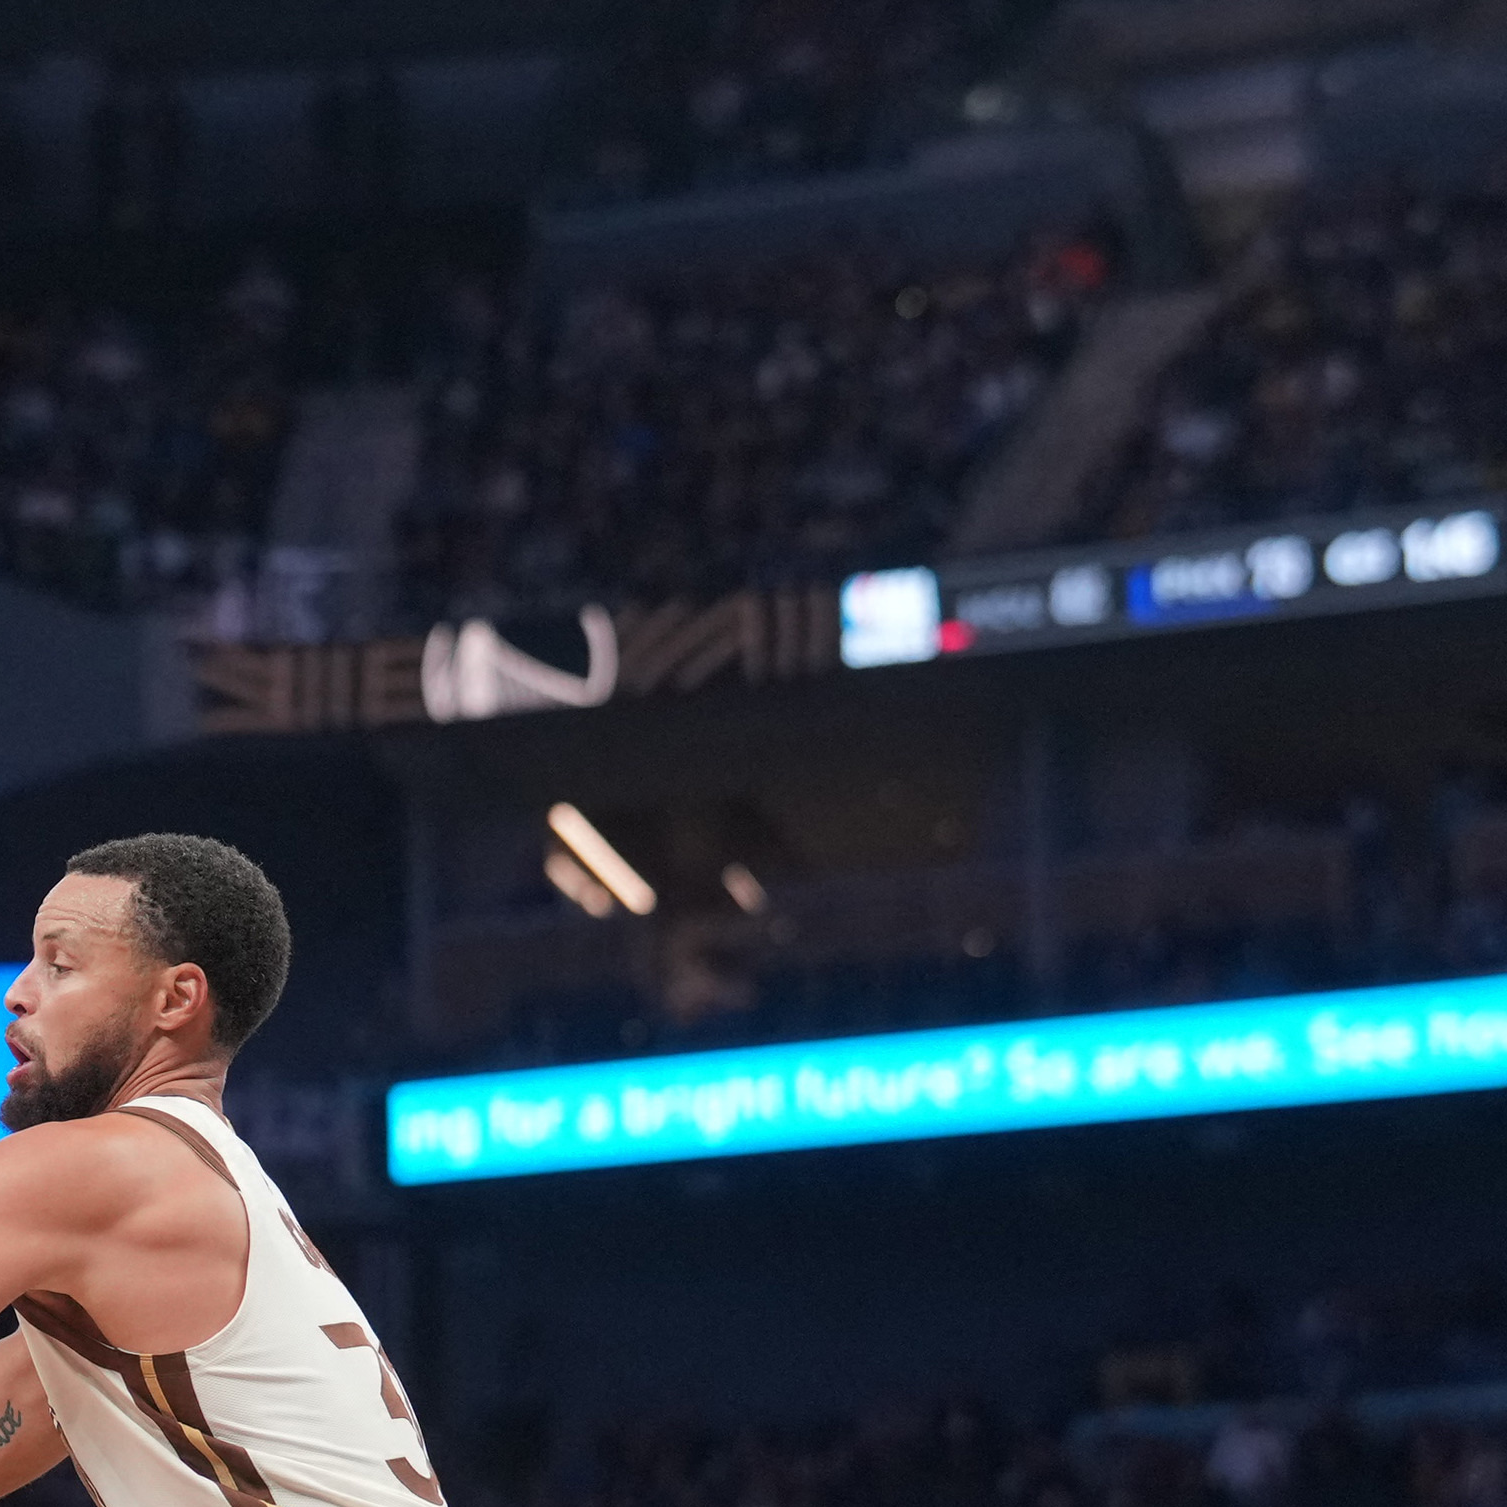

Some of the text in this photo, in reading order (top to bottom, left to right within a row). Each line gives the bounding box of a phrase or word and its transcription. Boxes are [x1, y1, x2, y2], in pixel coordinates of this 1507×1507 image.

[488, 1093, 565, 1148] for
[578, 1094, 615, 1143] a
[621, 1072, 785, 1147] bright
[1007, 1036, 1078, 1103] So
[1091, 1041, 1179, 1098] are
[1306, 1008, 1416, 1076] See
